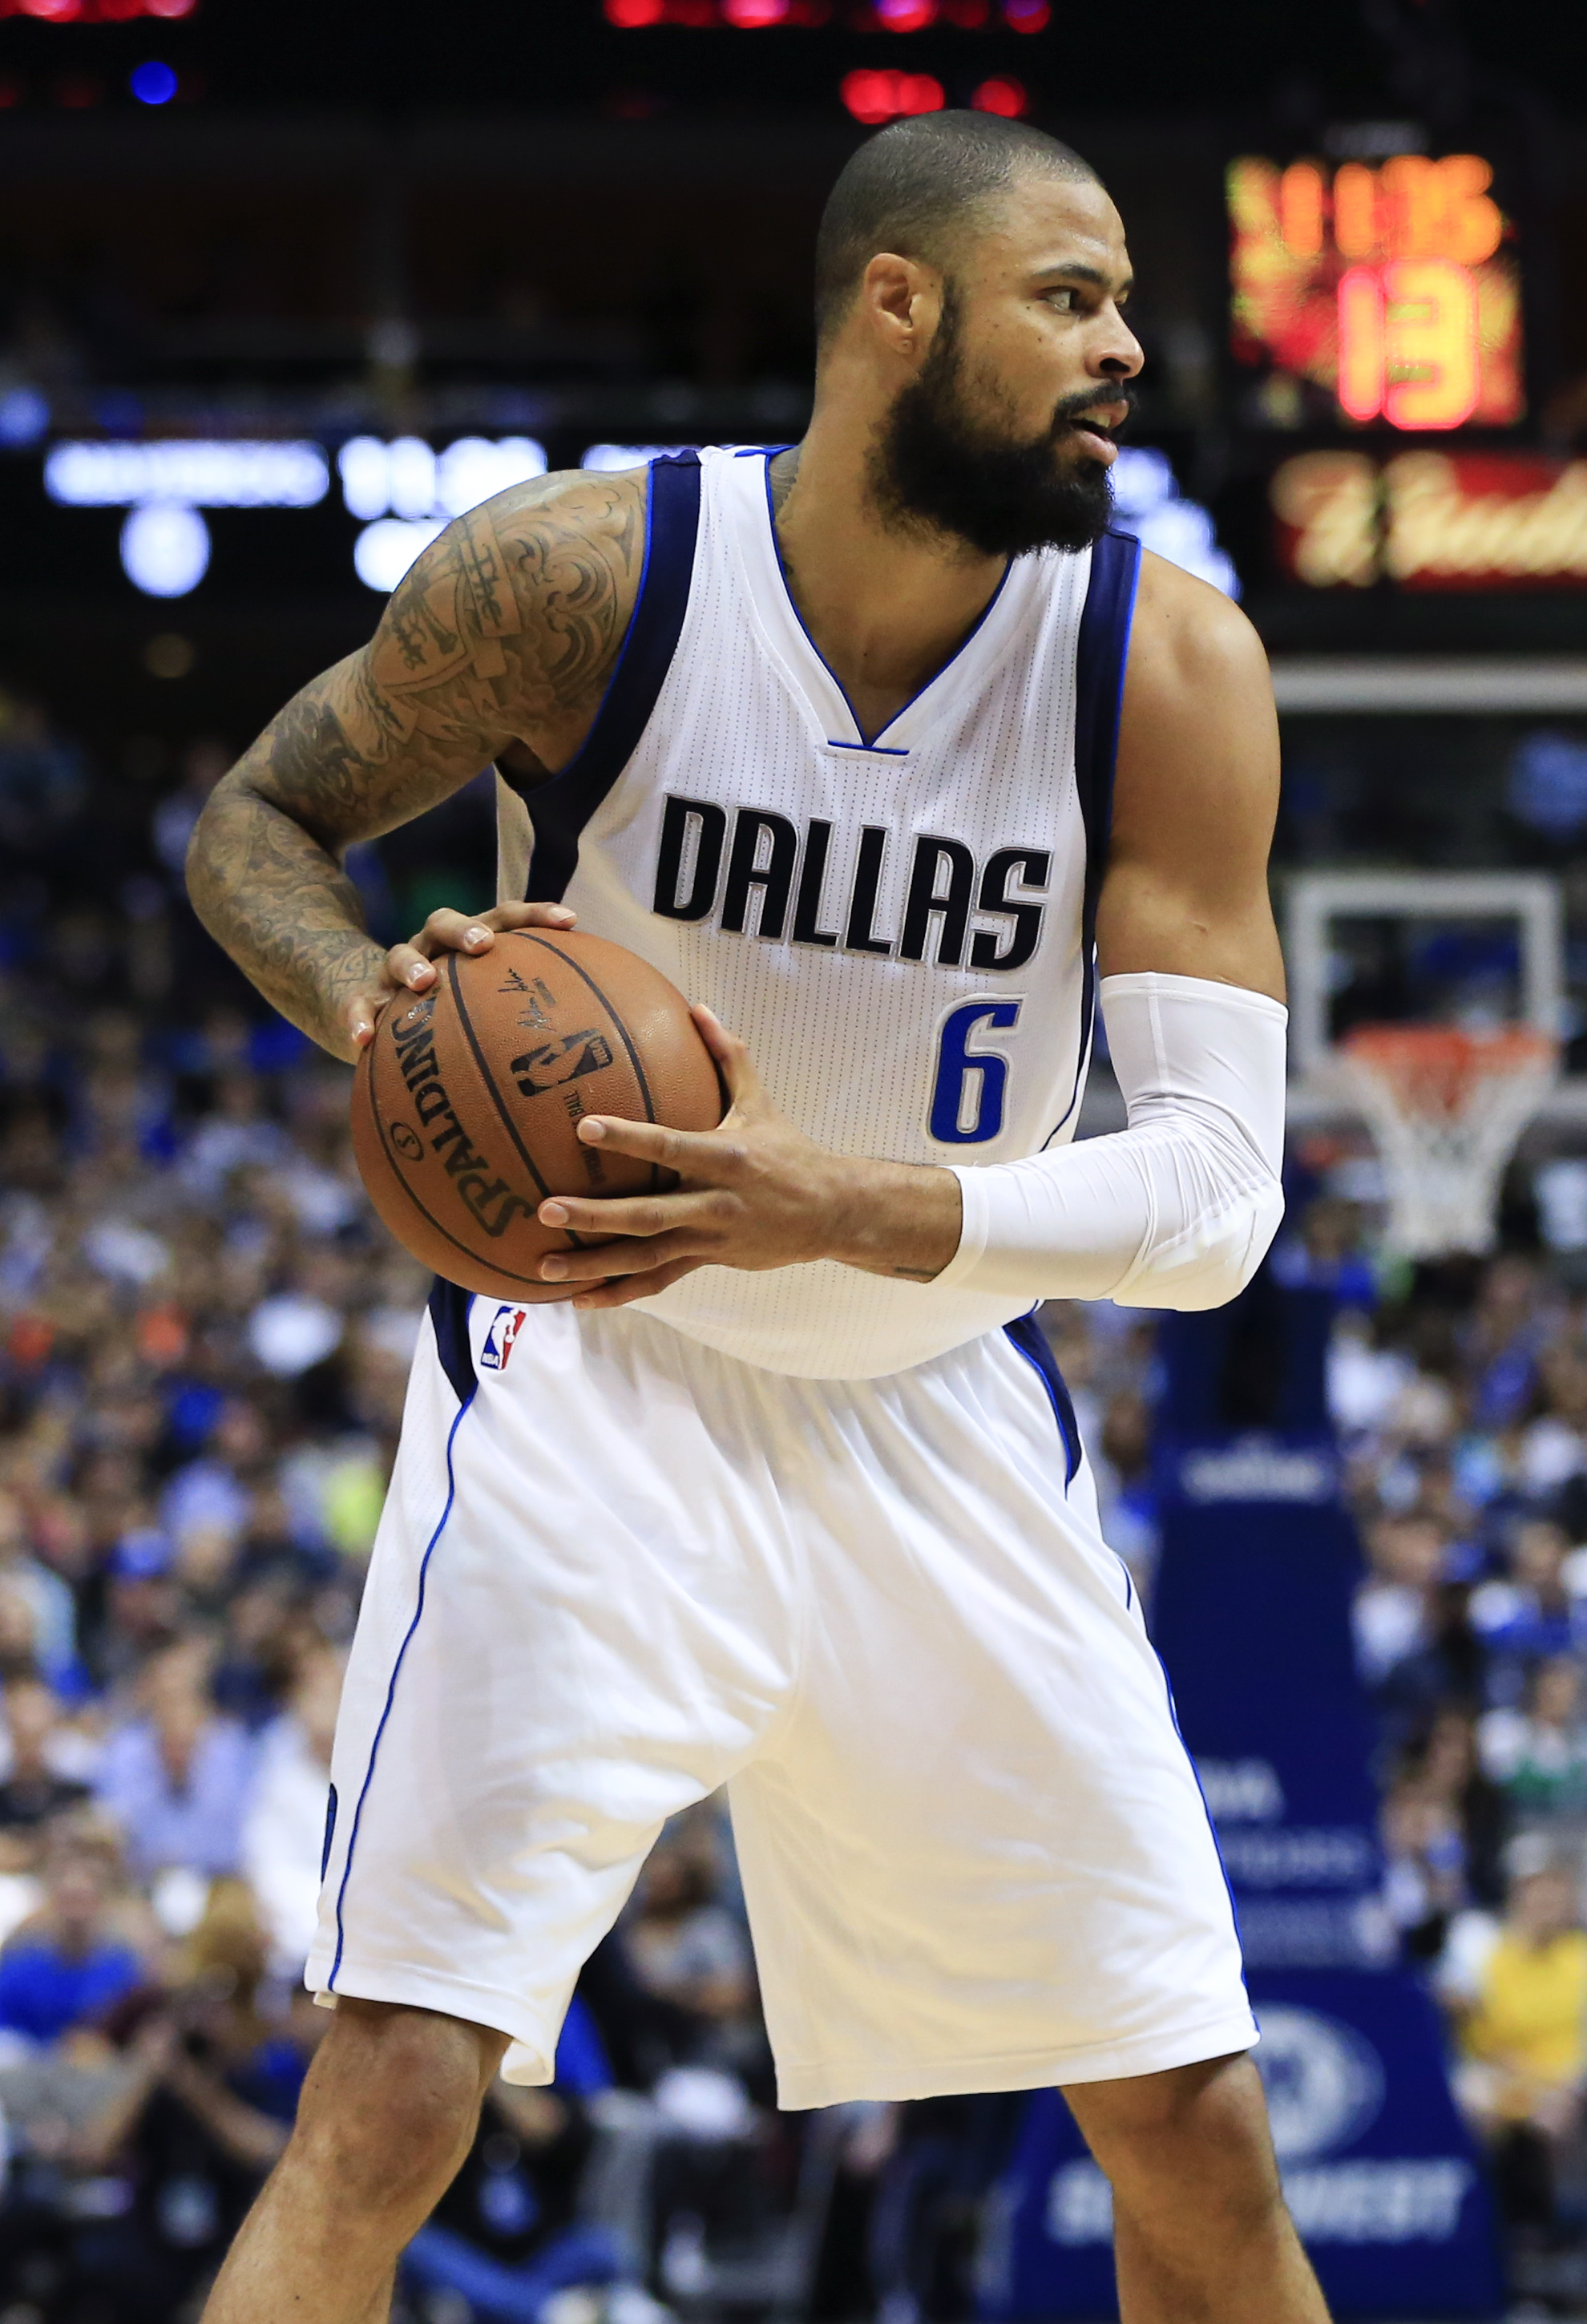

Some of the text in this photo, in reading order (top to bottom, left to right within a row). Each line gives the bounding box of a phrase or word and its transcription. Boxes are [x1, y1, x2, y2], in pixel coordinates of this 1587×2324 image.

[651, 793, 1053, 973] DALLAS
[391, 995, 538, 1237] SPALDING
[563, 1090, 585, 1118] BALL
[927, 993, 1028, 1147] 6
